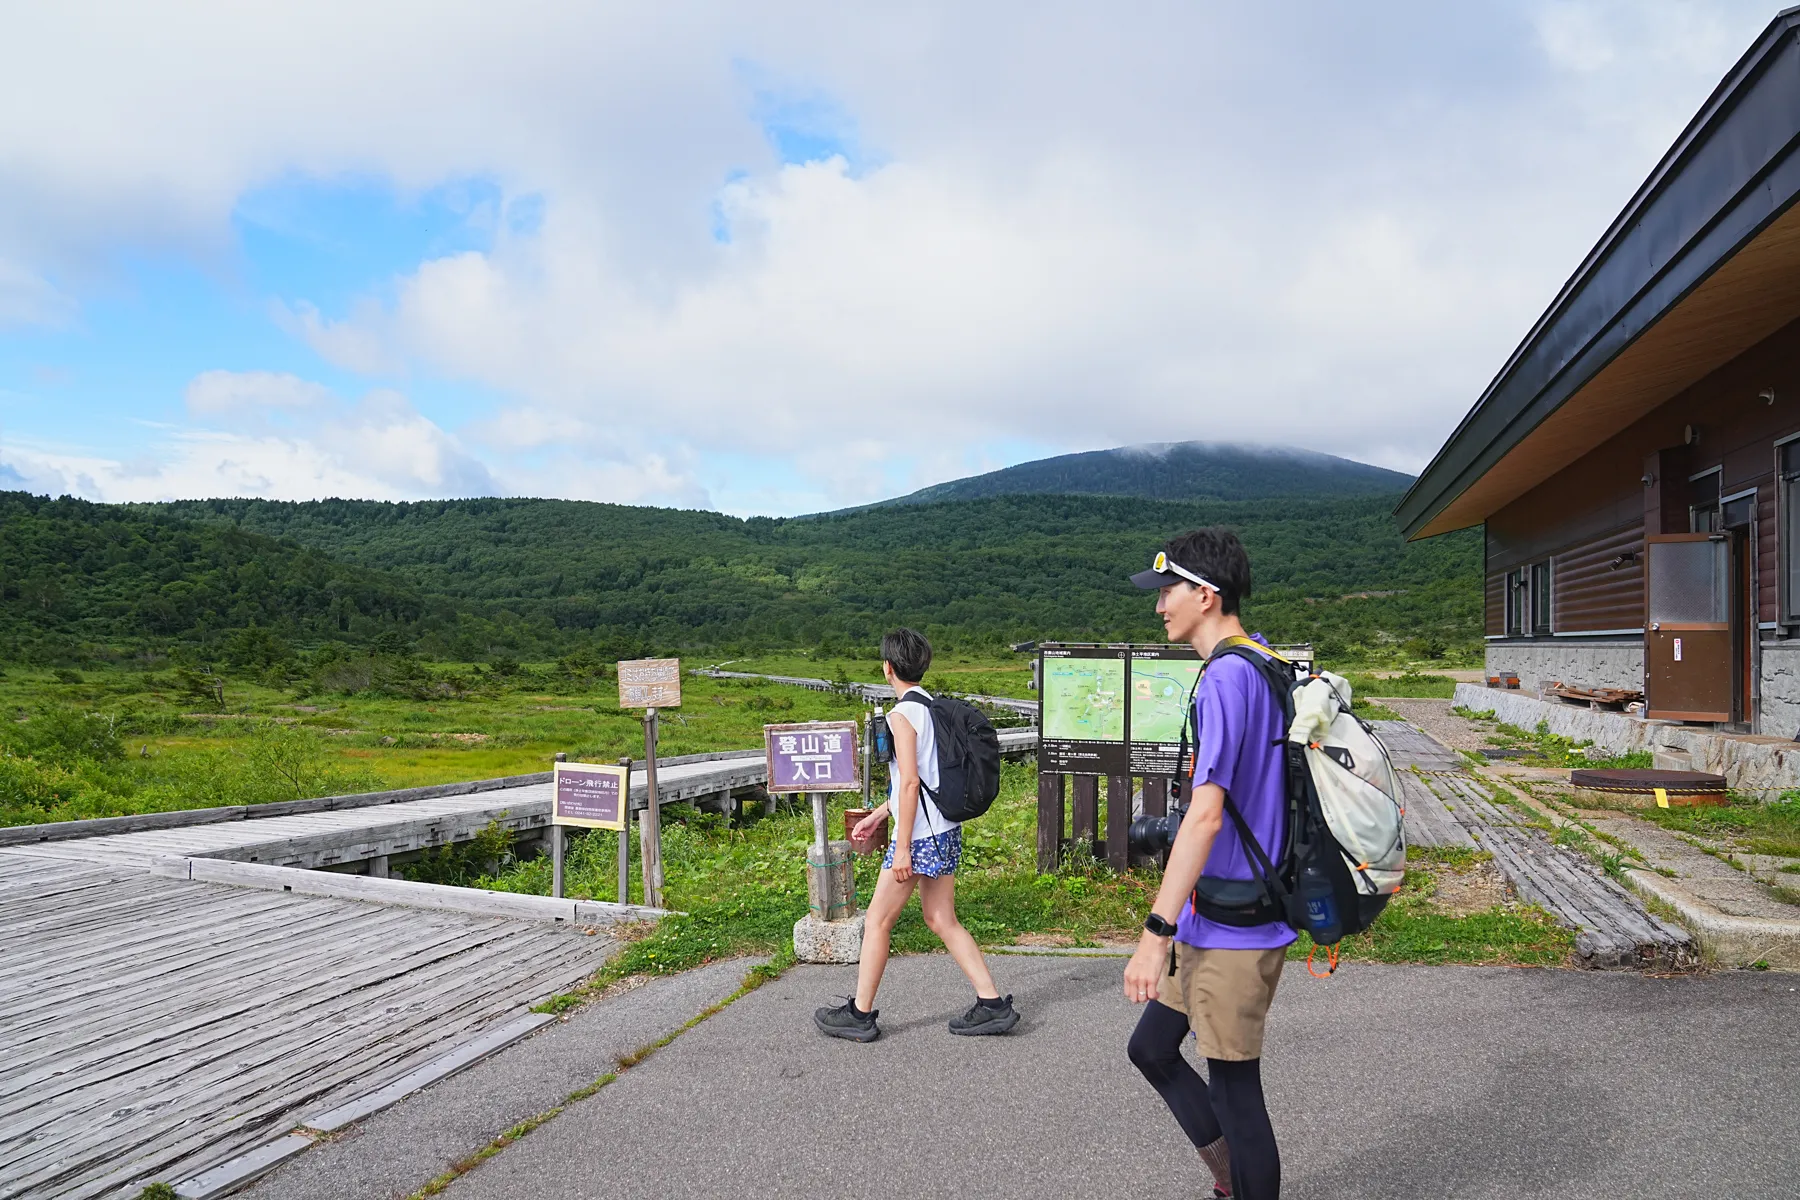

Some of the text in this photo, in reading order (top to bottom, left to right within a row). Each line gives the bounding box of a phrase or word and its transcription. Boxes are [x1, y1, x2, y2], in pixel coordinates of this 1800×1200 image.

[779, 734, 842, 754] 登山道
[792, 762, 831, 780] 入口
[559, 777, 618, 789] ドローン飛行禁止
